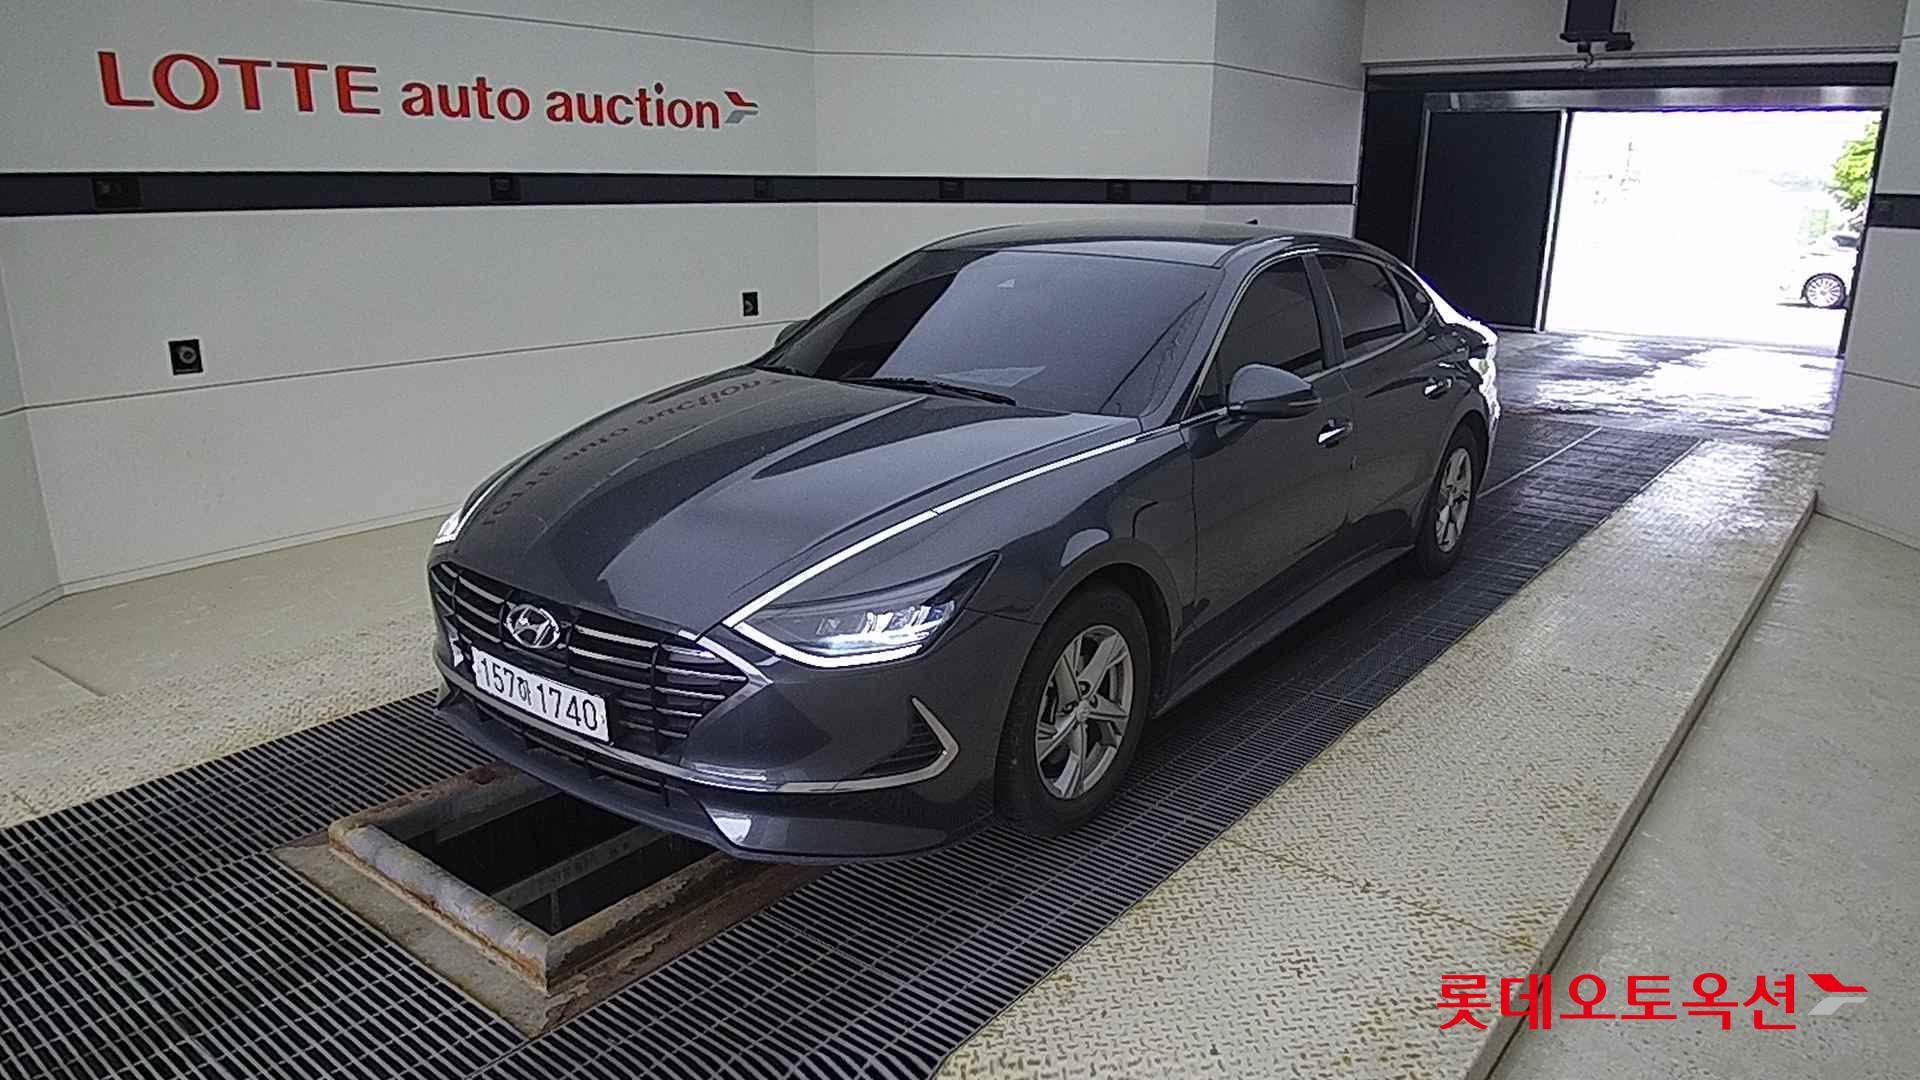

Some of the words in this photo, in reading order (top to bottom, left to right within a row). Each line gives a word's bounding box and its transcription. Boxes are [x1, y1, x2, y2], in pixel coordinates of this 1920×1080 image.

[98, 51, 380, 114] LOTTE
[402, 77, 530, 121] auto
[546, 82, 722, 129] auction
